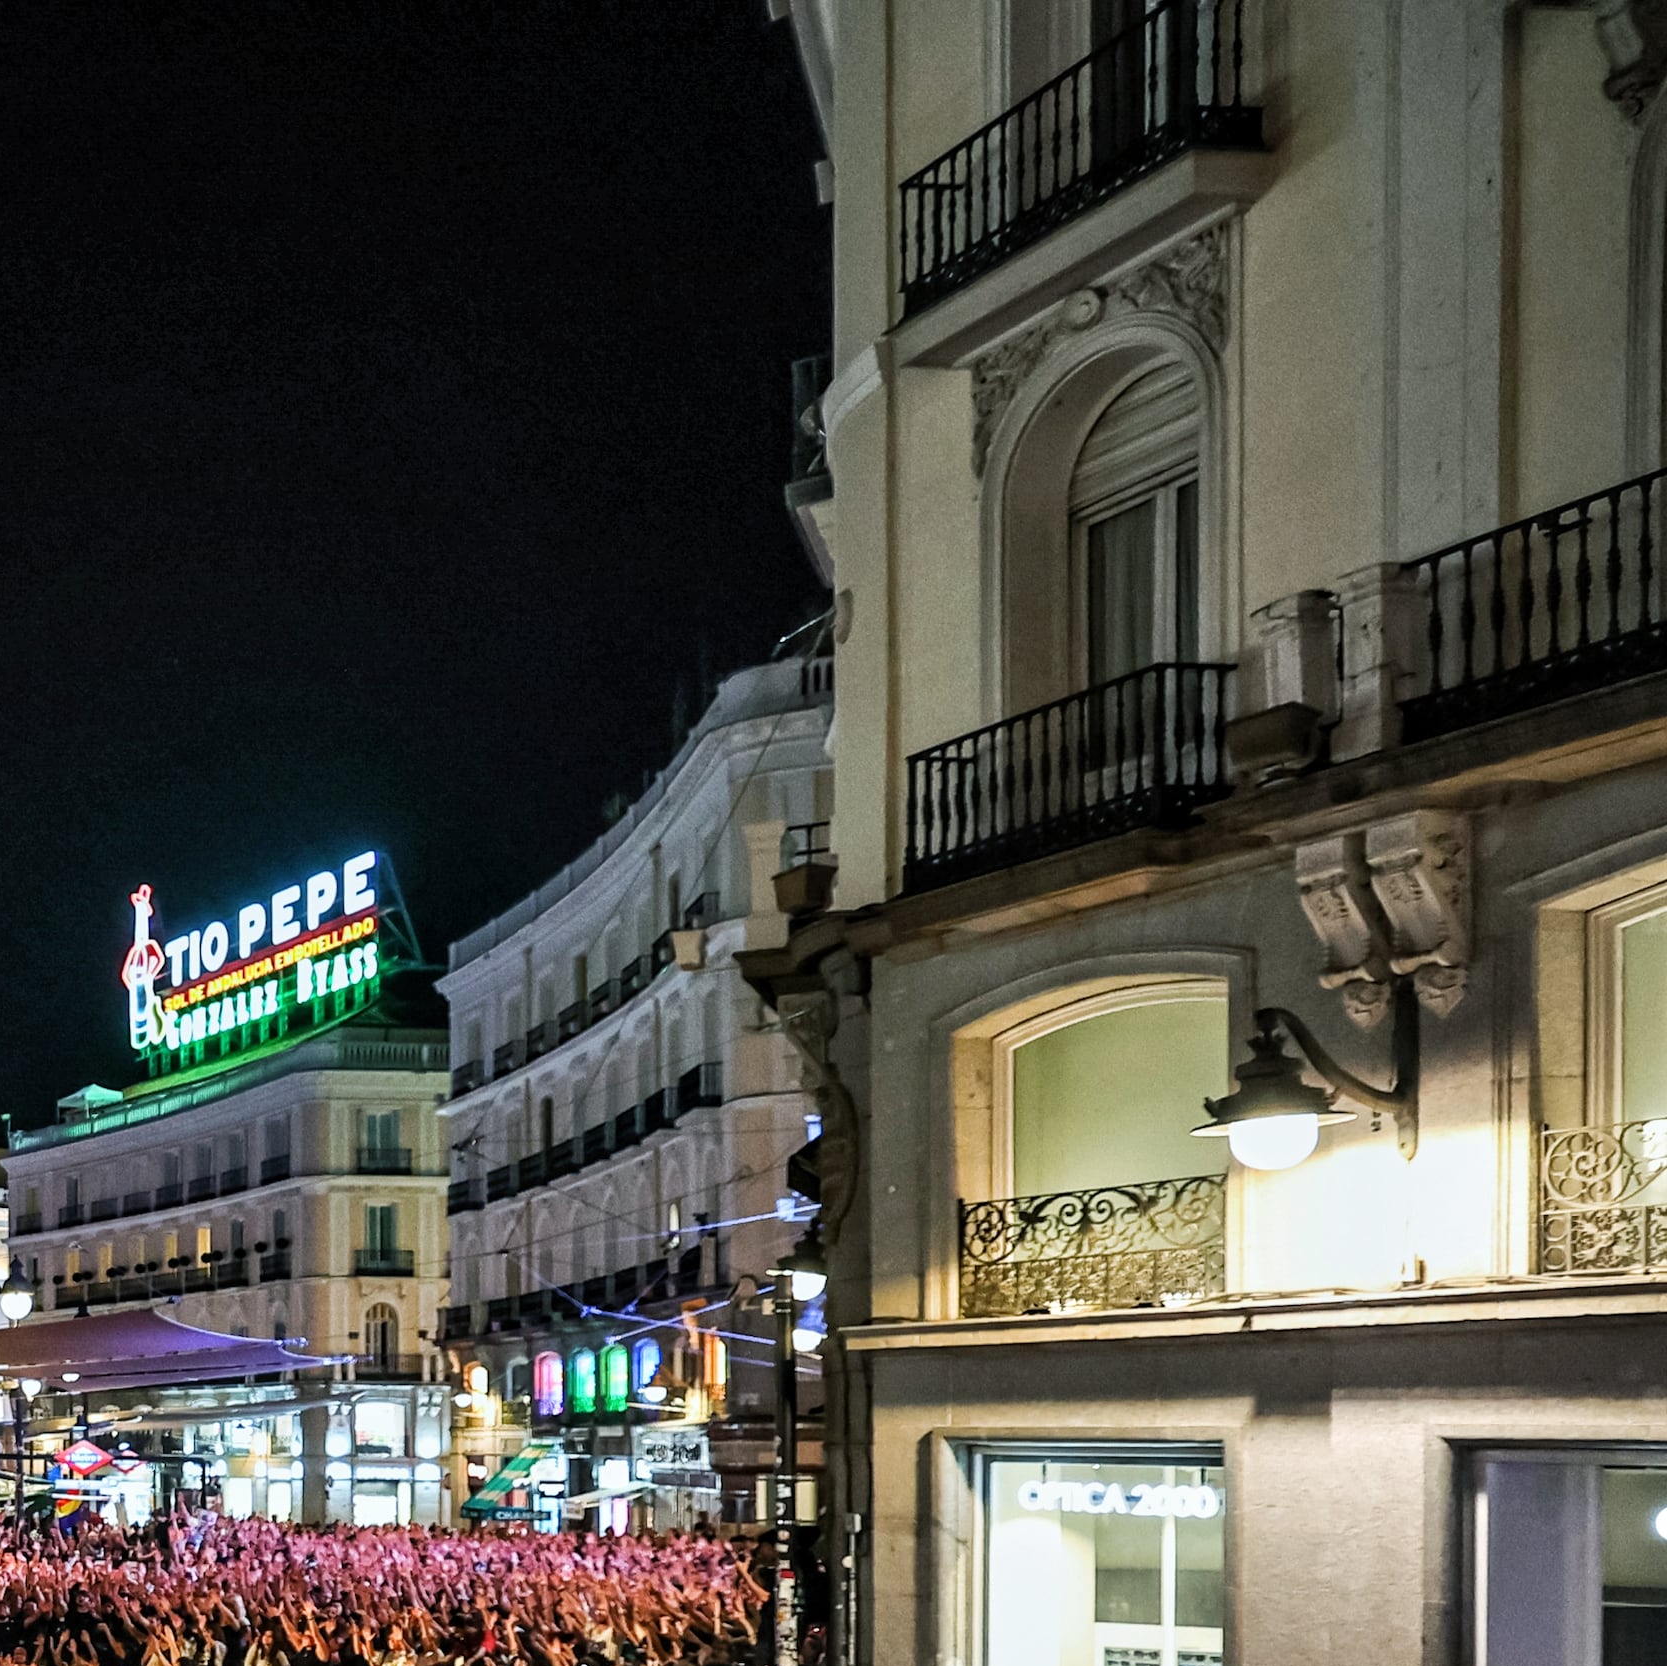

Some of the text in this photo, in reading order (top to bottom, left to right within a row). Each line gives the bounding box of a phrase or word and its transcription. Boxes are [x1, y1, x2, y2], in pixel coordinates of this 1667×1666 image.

[165, 850, 376, 987] TIO PEPE
[189, 984, 205, 1005] DE
[296, 941, 378, 1003] BYASS
[1129, 1483, 1220, 1519] 2000
